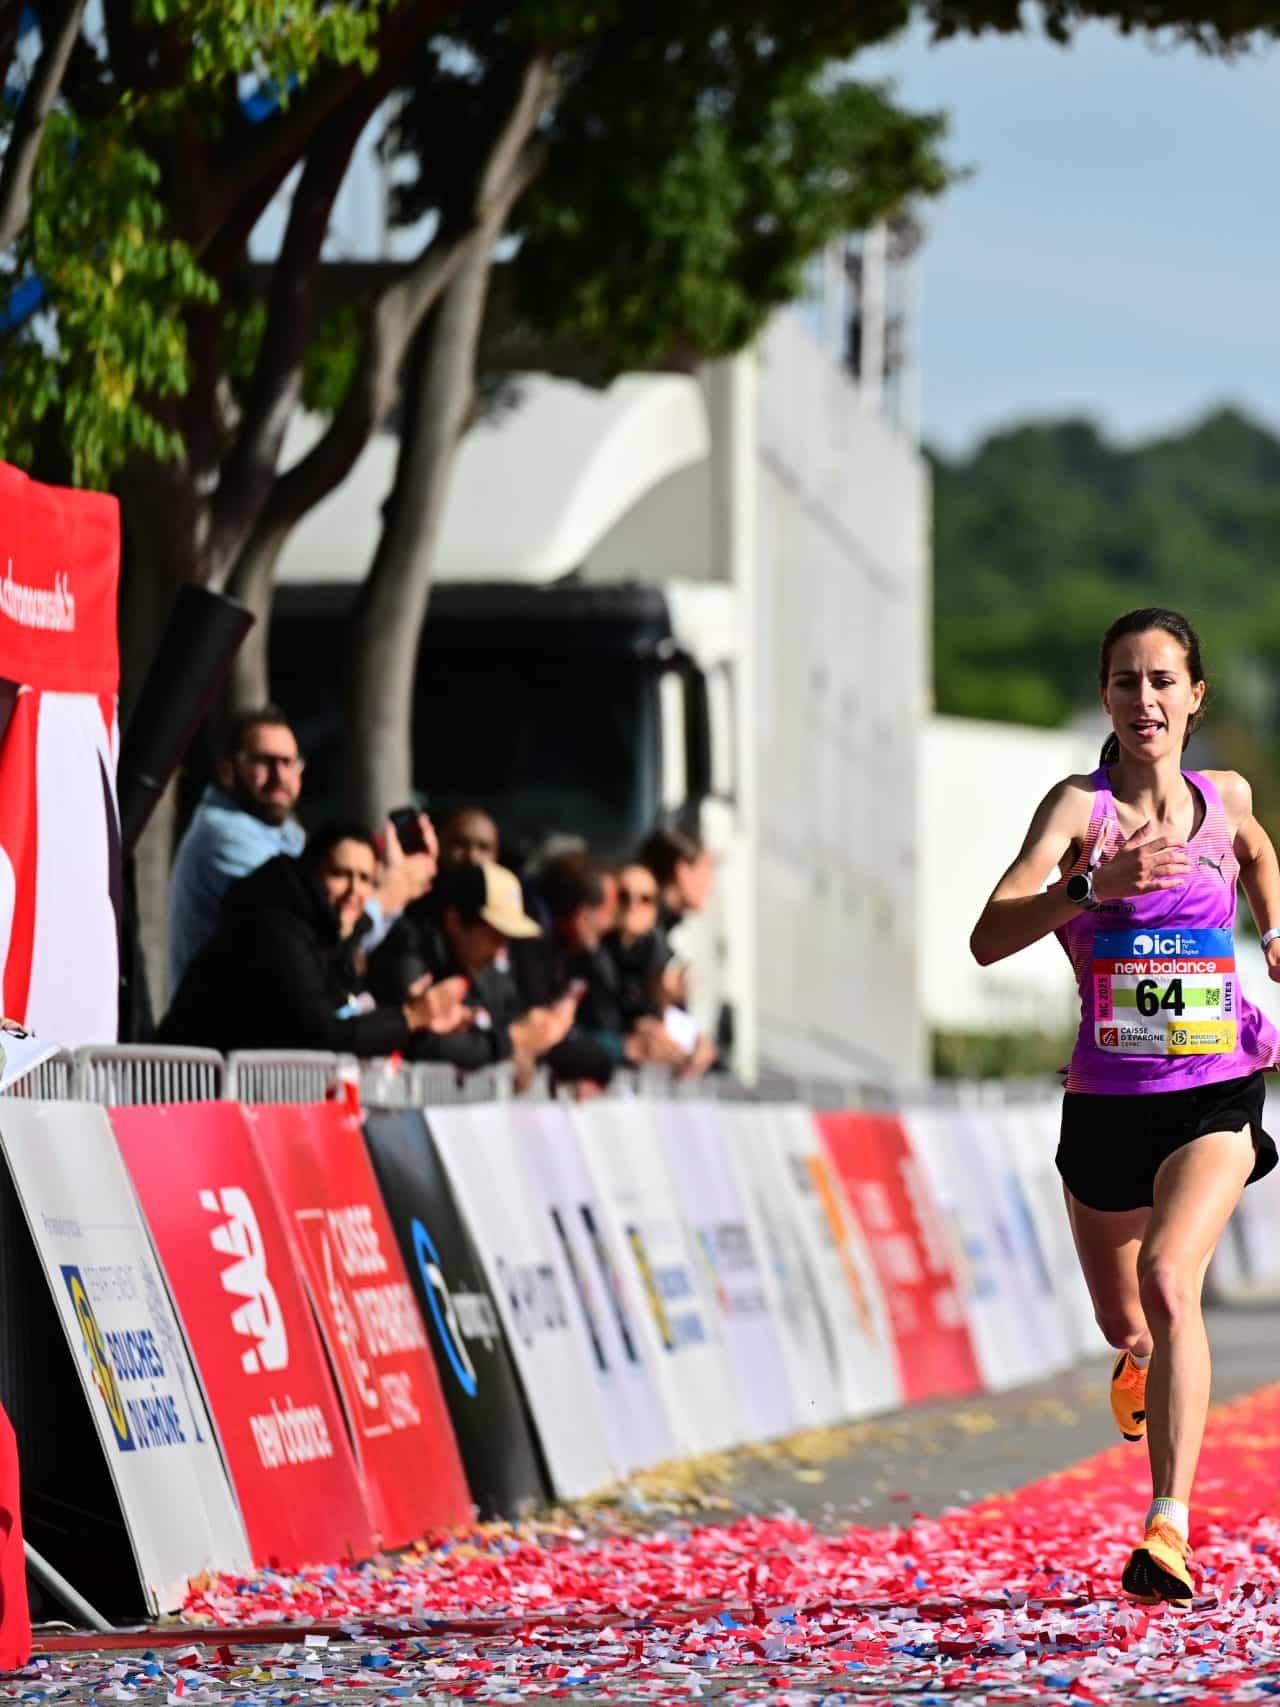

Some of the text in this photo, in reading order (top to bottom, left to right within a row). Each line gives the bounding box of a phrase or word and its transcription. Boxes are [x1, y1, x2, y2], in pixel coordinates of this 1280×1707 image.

[1154, 934, 1181, 955] ici
[1115, 959, 1216, 974] new balance
[1136, 978, 1185, 1017] 64
[1224, 981, 1232, 1012] ELITES
[105, 1328, 165, 1381] BOUCHES
[126, 1398, 151, 1448] DU
[249, 1394, 334, 1471] new balance
